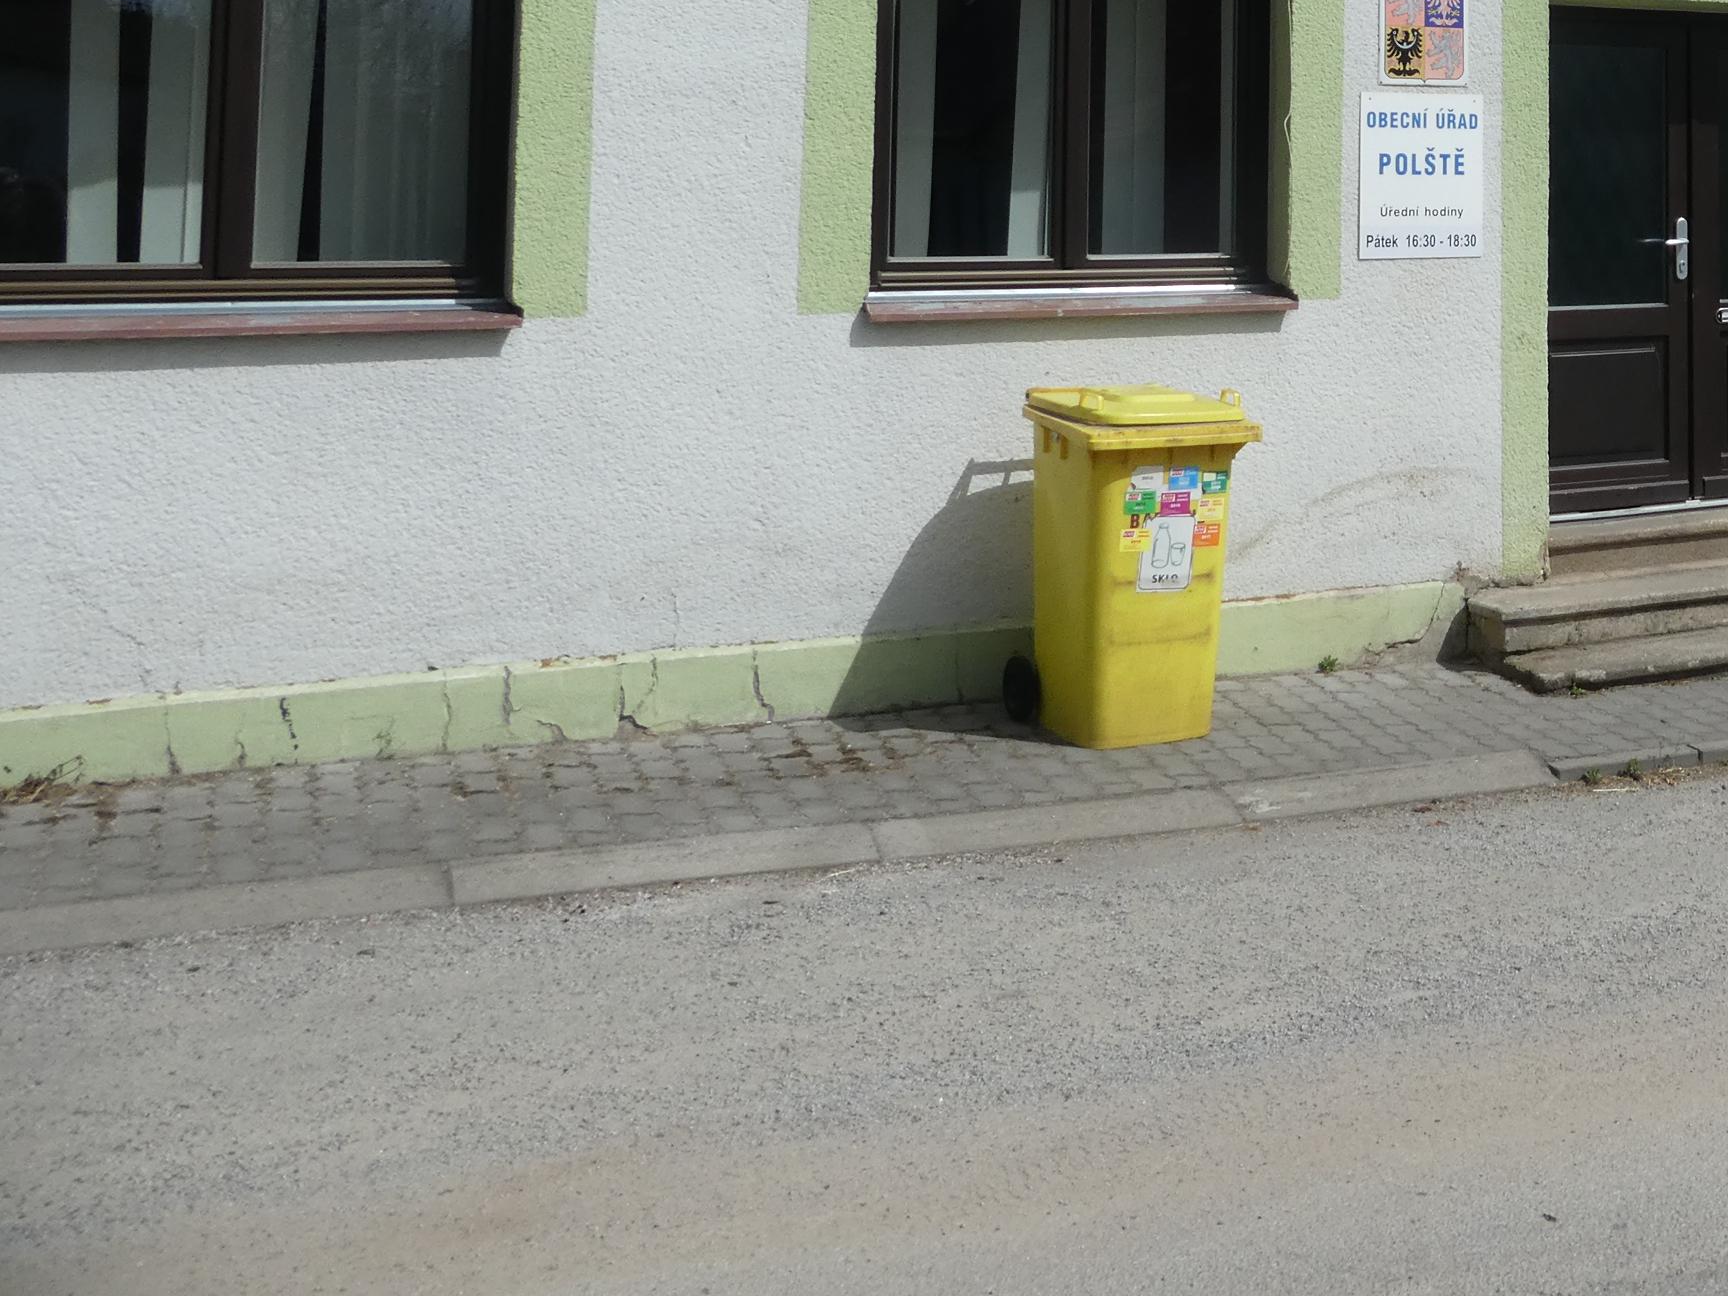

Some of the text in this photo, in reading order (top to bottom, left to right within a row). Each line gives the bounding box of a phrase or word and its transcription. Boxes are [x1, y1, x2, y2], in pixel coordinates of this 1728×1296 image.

[1366, 108, 1479, 130] OBECNÍ ÚŘAD
[1378, 147, 1466, 176] POLŠTĚ
[1379, 204, 1464, 219] Úřední hodiny
[1366, 234, 1399, 249] Pátek
[1405, 234, 1436, 248] 16:30
[1446, 234, 1477, 248] 18:30
